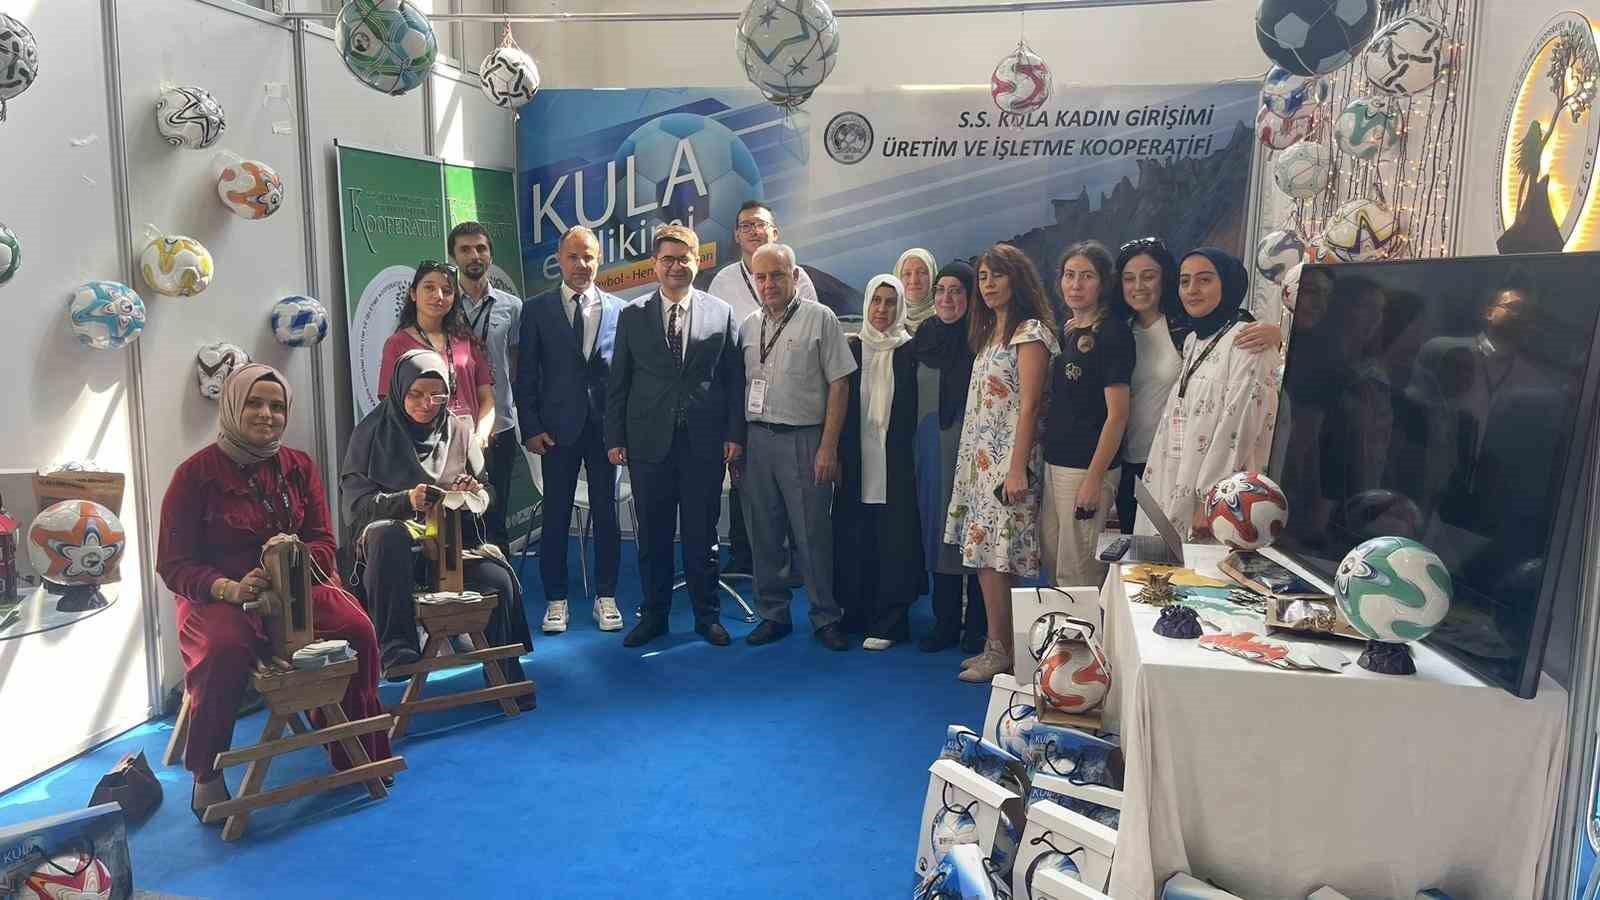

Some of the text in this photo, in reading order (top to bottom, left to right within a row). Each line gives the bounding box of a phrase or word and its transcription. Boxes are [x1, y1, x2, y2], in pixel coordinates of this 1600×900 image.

[958, 111, 991, 128] S.S.
[1055, 109, 1120, 128] KADIN
[1125, 104, 1215, 130] GİRİŞİMİ
[882, 136, 958, 157] ÜRETİM
[964, 140, 989, 157] VE
[992, 136, 1076, 160] İŞLETME
[1080, 134, 1213, 156] KOOPERATİFİ
[532, 137, 708, 244] KULA
